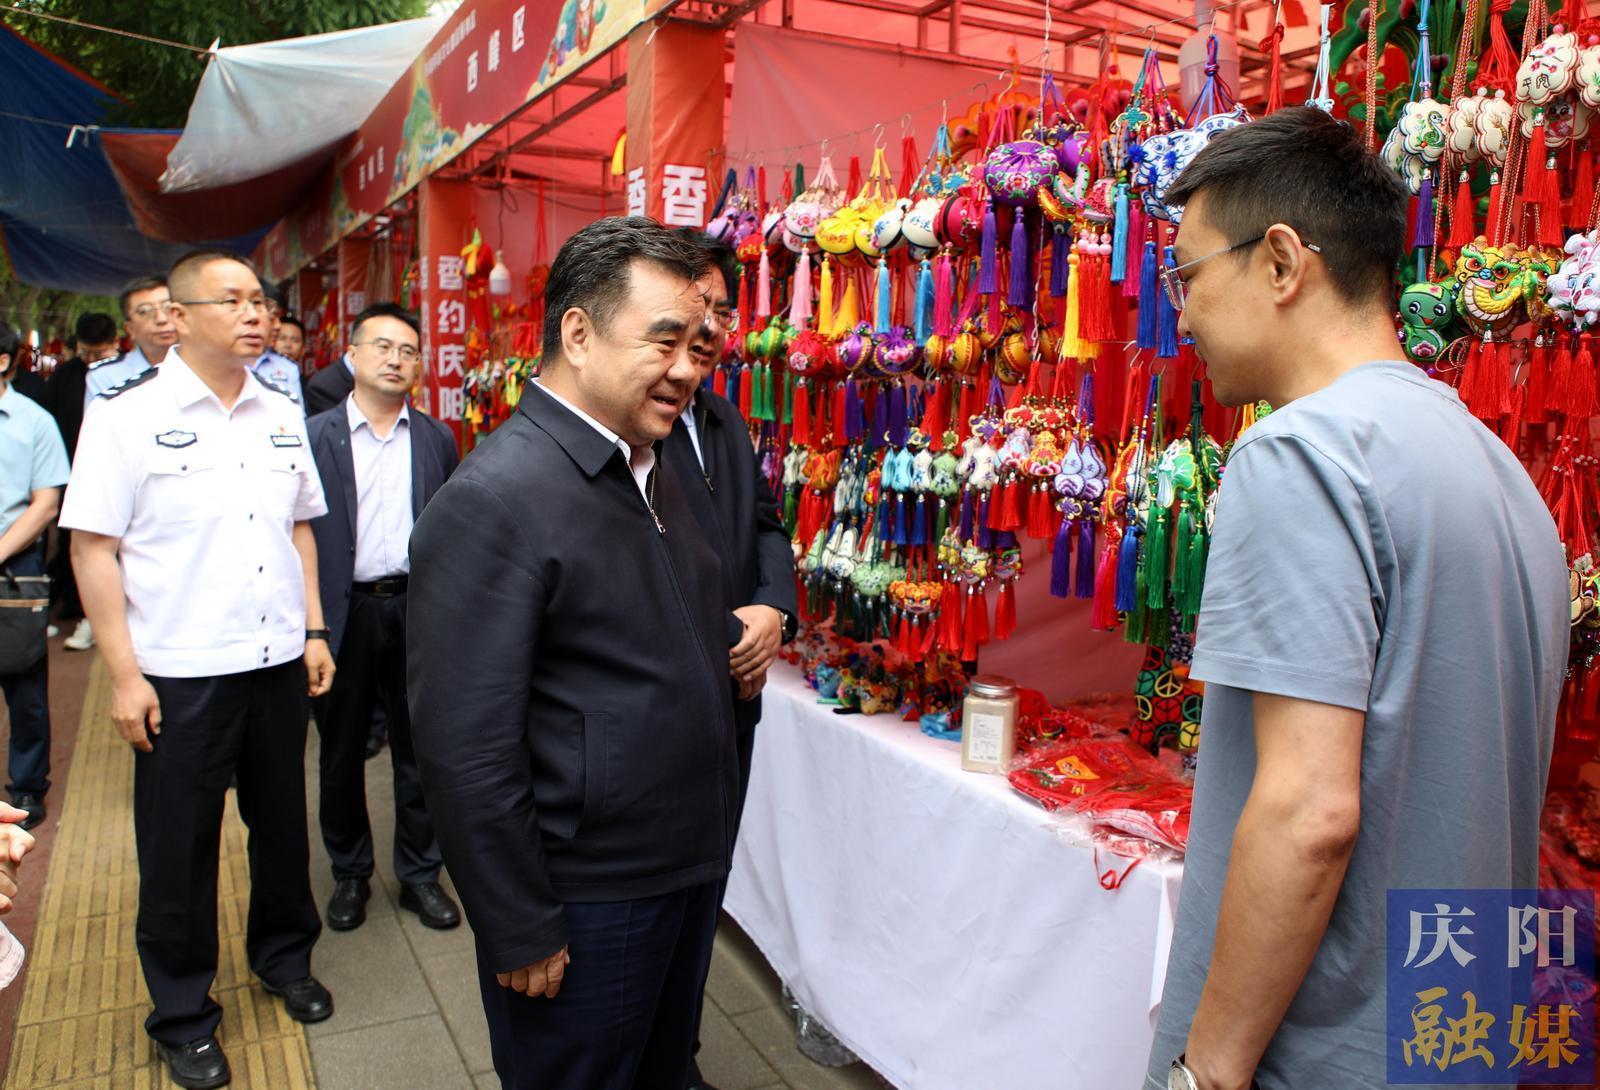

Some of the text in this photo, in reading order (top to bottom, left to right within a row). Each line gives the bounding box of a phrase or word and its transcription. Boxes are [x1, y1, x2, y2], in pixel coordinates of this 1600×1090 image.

[662, 164, 707, 227] 香
[438, 255, 465, 421] 香约庆阳
